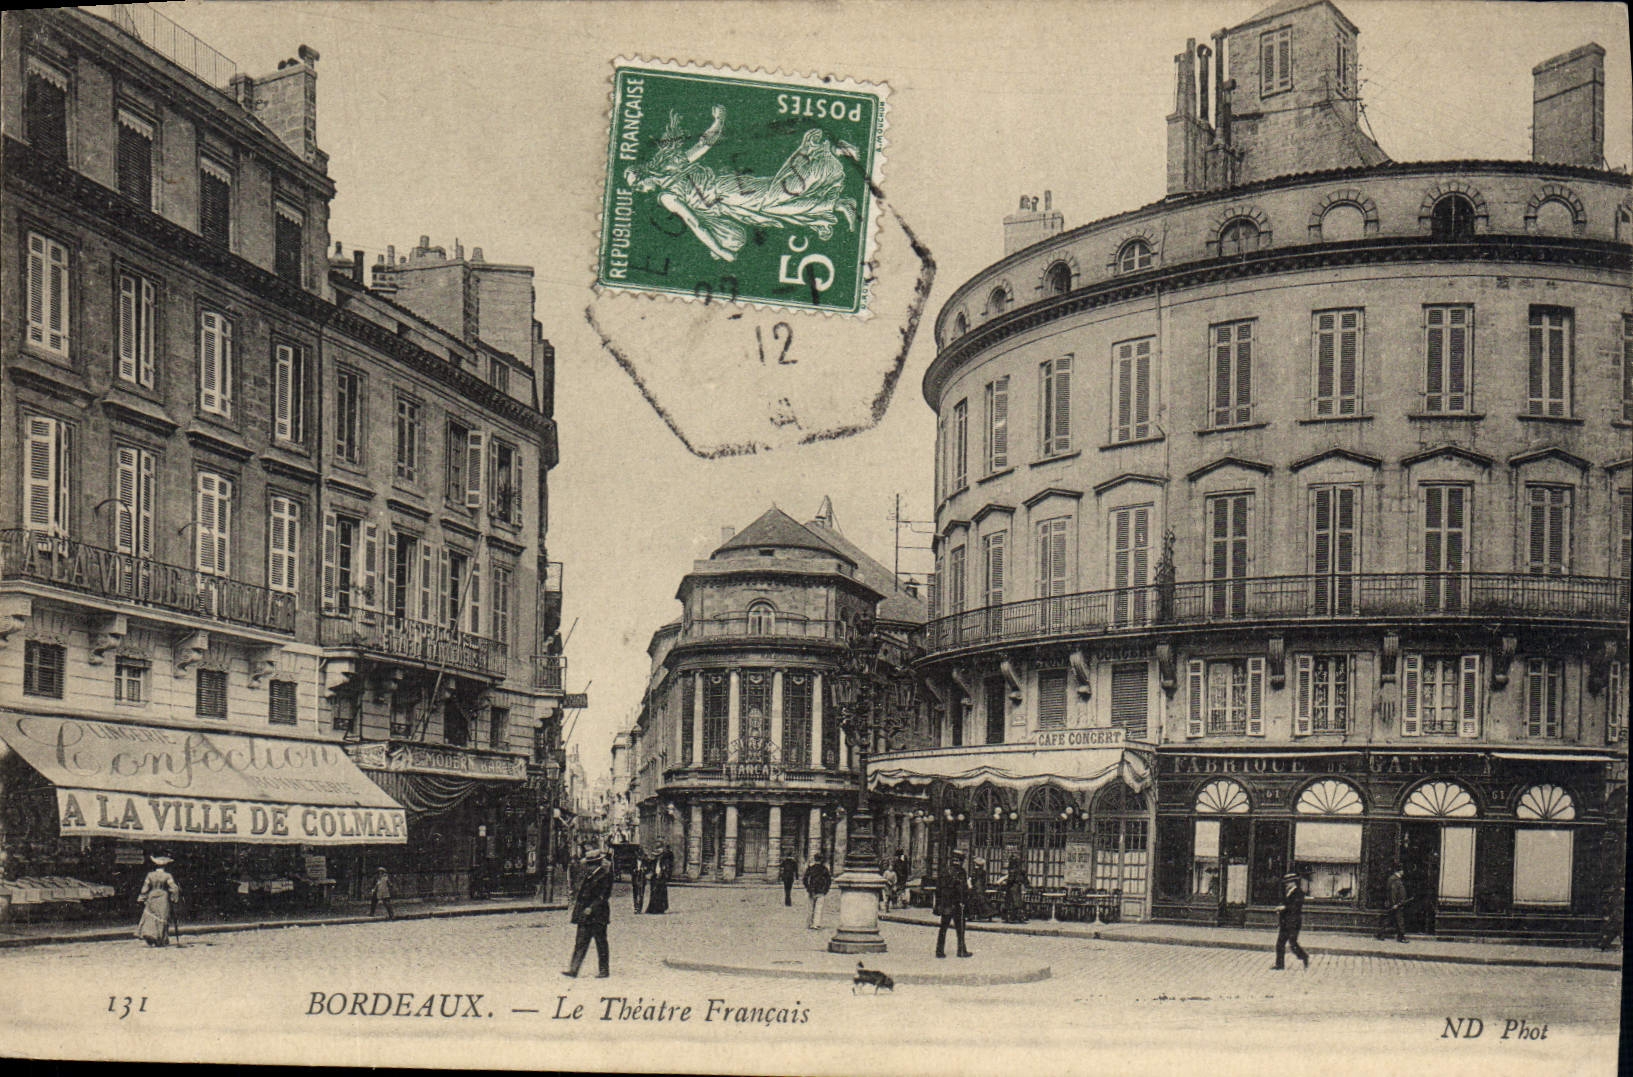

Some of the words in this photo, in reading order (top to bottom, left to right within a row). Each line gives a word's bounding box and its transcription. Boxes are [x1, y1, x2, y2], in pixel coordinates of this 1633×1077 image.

[620, 77, 645, 161] FRANÇAISE
[777, 94, 862, 122] POSTES
[755, 321, 798, 366] 12
[1068, 731, 1122, 745] CONCERT
[1174, 756, 1306, 774] FABRIQUE
[62, 793, 86, 827] A
[96, 794, 144, 830] LA
[149, 800, 237, 834] VILLE
[251, 806, 289, 836] DE
[302, 808, 407, 838] COLMAR
